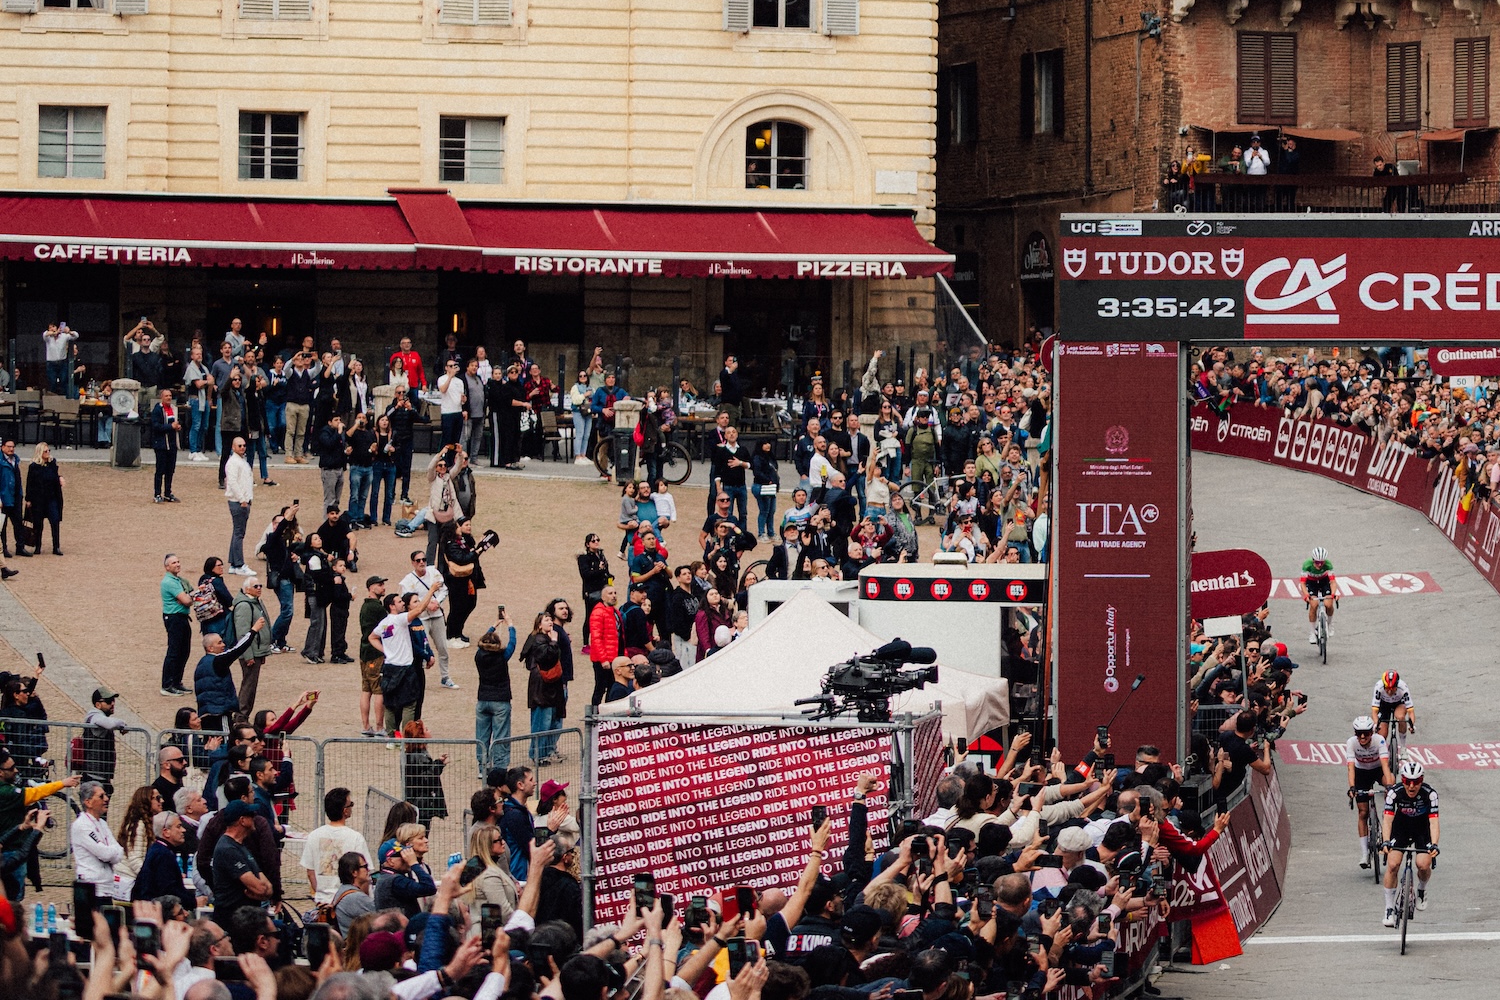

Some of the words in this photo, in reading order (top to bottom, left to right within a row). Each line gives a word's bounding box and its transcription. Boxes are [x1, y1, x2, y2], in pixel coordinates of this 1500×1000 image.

[1070, 222, 1096, 233] UCI
[33, 243, 192, 262] CAFFETTERIA
[514, 256, 662, 274] RISTORANTE
[797, 261, 907, 276] PIZZERIA
[1094, 251, 1216, 275] TUDOR
[1097, 297, 1236, 318] 3:35:42
[1437, 347, 1497, 363] Continental
[1456, 377, 1467, 386] 50
[1075, 503, 1147, 535] ITA
[628, 742, 650, 754] RIDE
[652, 736, 678, 749] INTO
[681, 732, 701, 744] THE
[703, 725, 743, 739] LEGEND
[630, 755, 655, 768] RIDE
[657, 750, 684, 763] INTO
[685, 745, 707, 757] THE
[709, 736, 751, 752] LEGEND
[754, 730, 777, 743] RIDE
[779, 725, 805, 738] INTO
[633, 770, 656, 782] RIDE
[658, 764, 684, 777] INTO
[686, 760, 706, 772] THE
[709, 751, 749, 767] LEGEND
[752, 746, 777, 758] RIDE
[779, 739, 806, 753] INTO
[808, 735, 830, 747] THE
[831, 727, 874, 743] LEGEND
[1456, 750, 1490, 761] più
[636, 783, 660, 796] RIDE
[662, 777, 690, 791] INTO
[691, 772, 713, 785] THE
[714, 764, 757, 780] LEGEND
